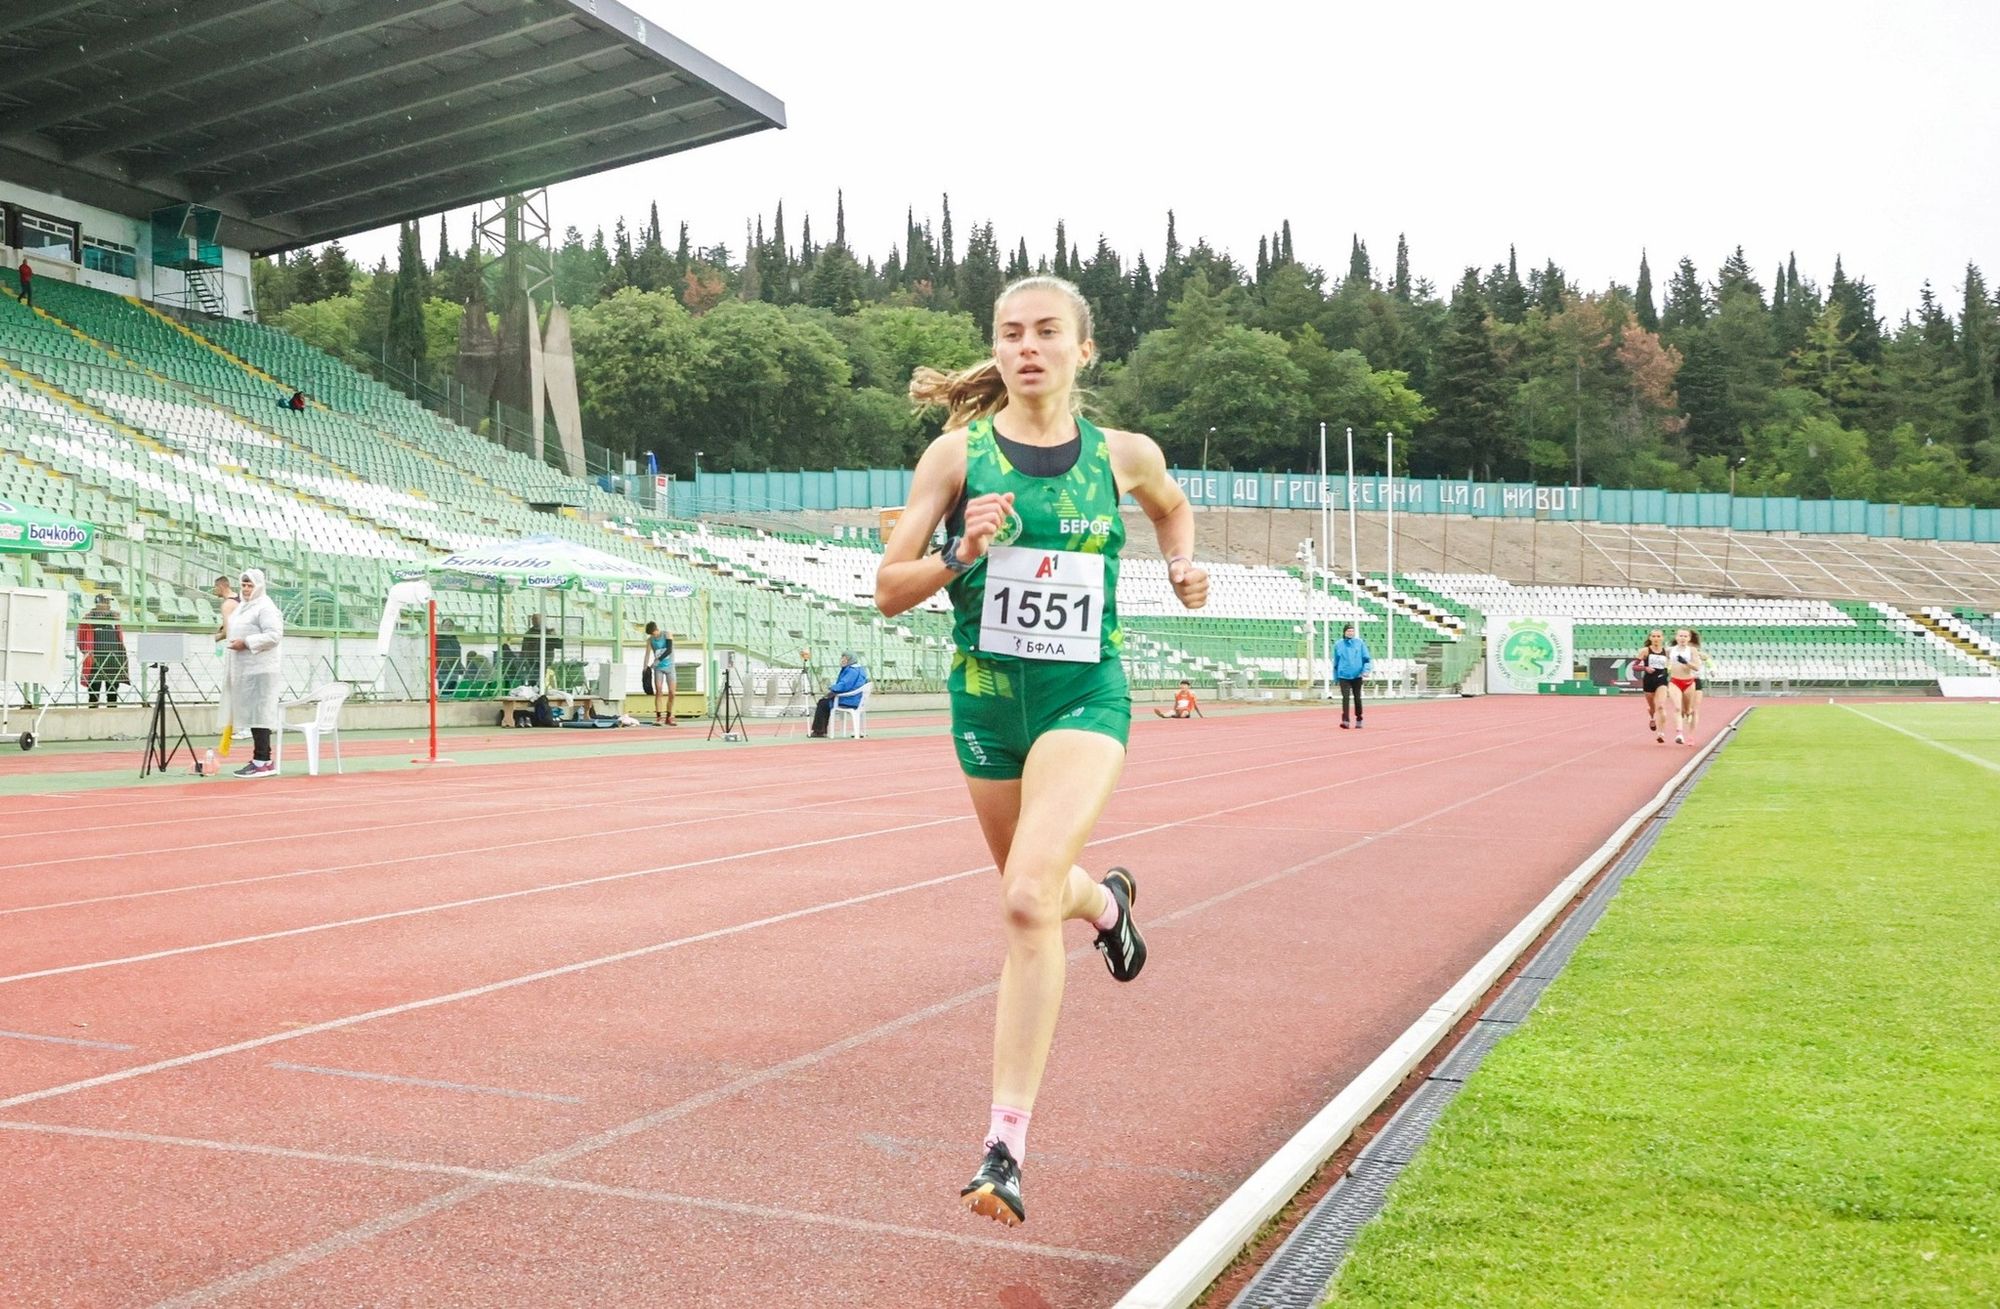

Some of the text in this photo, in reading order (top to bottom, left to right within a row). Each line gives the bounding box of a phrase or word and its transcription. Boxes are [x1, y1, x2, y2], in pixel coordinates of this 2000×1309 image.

[1176, 477, 1217, 499] РОЕ
[1233, 478, 1258, 501] ДО
[1440, 485, 1486, 509] ЦЯЛ
[1503, 487, 1582, 511] ЖИВОТ
[30, 524, 85, 542] Бачково
[1060, 519, 1111, 535] БЕРОЕ
[441, 555, 551, 569] Бачково
[1035, 554, 1059, 579] A1
[994, 587, 1091, 632] 1551
[1026, 641, 1066, 655] БФЛА
